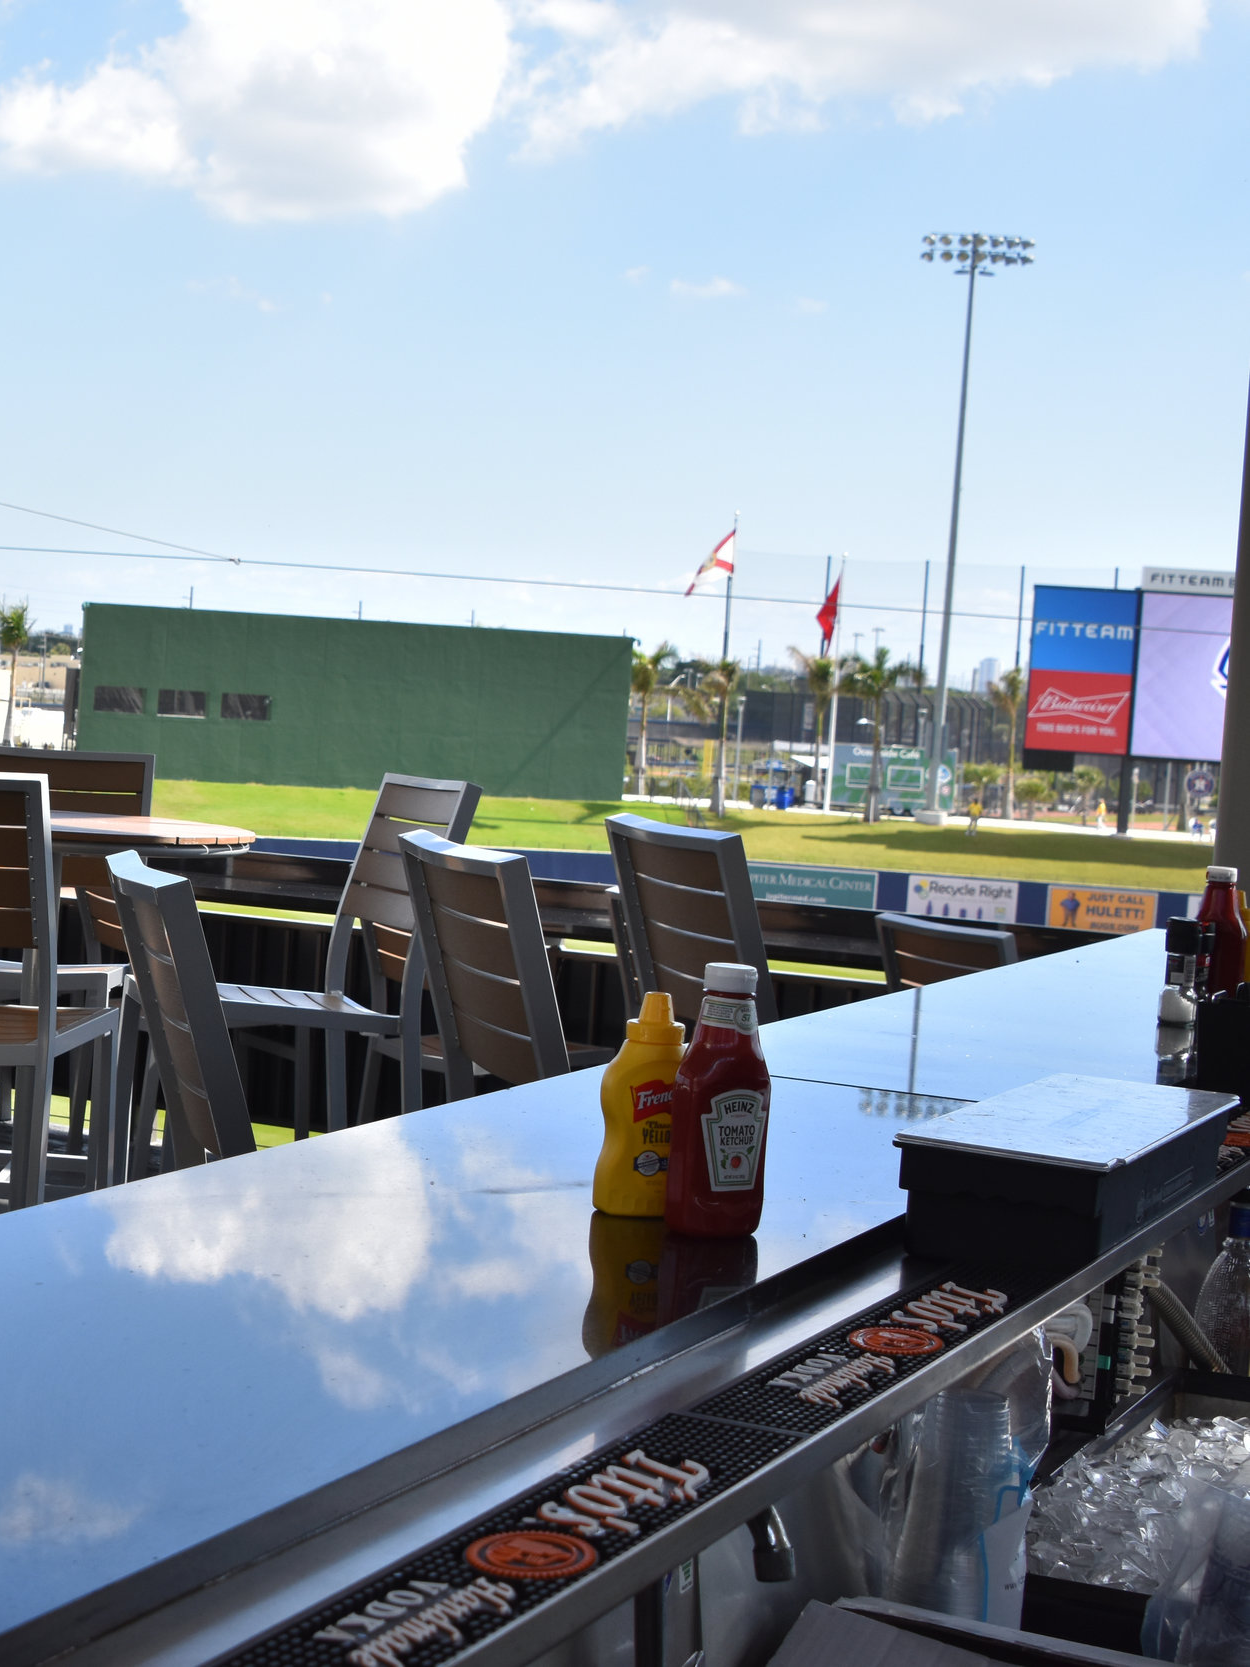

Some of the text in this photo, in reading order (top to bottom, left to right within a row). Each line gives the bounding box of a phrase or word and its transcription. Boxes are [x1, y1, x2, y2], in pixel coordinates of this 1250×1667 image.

[1150, 571, 1225, 588] FITTEAM
[1034, 620, 1135, 641] FITTEAM
[1038, 694, 1118, 713] Budweiser
[750, 873, 777, 885] PITER
[930, 881, 1013, 900] Recycle Right
[1087, 893, 1145, 905] JUST CALL
[1085, 906, 1145, 920] HULETT!
[723, 1101, 754, 1115] HEINZ
[642, 1127, 671, 1145] YELLO
[718, 1124, 756, 1137] TOMATO
[719, 1135, 754, 1146] KETCHUP
[766, 1353, 849, 1389] VODKA
[313, 1579, 449, 1643] VODKA
